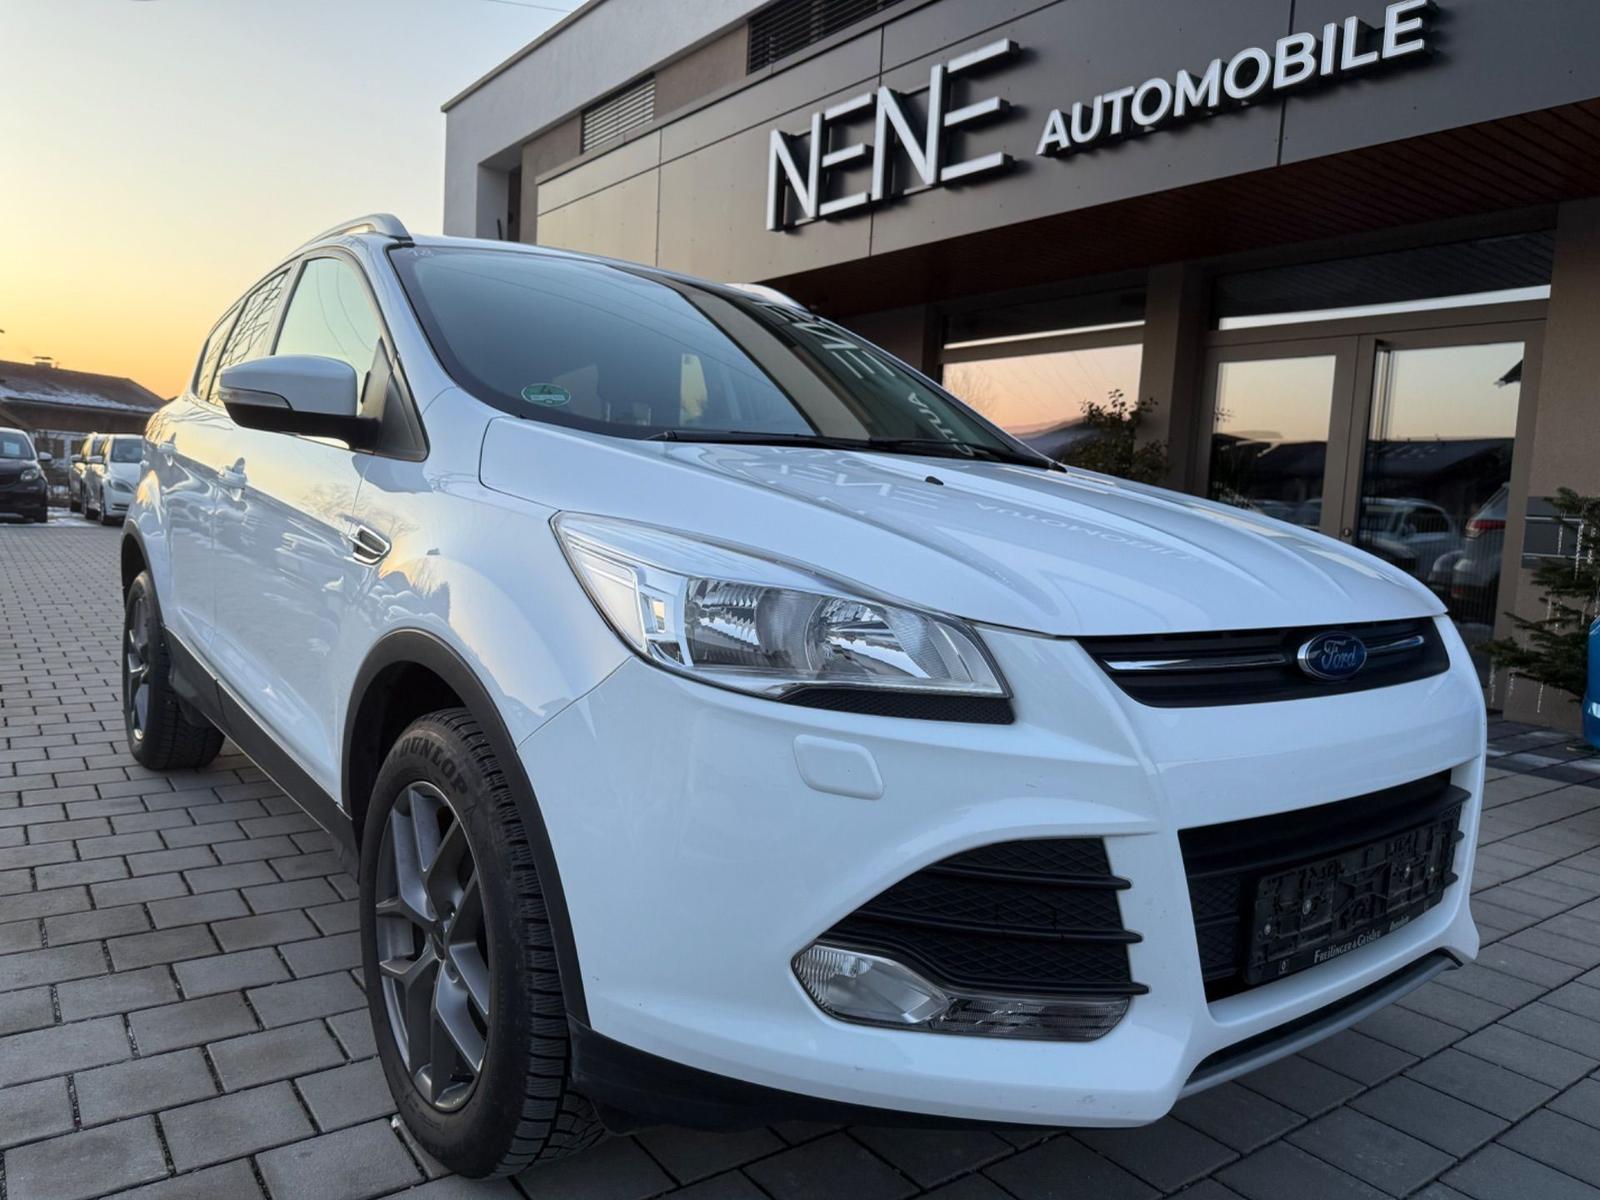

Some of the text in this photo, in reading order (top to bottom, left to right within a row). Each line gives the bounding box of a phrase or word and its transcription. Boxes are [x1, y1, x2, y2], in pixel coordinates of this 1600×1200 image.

[766, 0, 1429, 231] NENE AUTOMOBILE
[1321, 639, 1357, 670] Ford
[400, 736, 468, 794] DUNLOP
